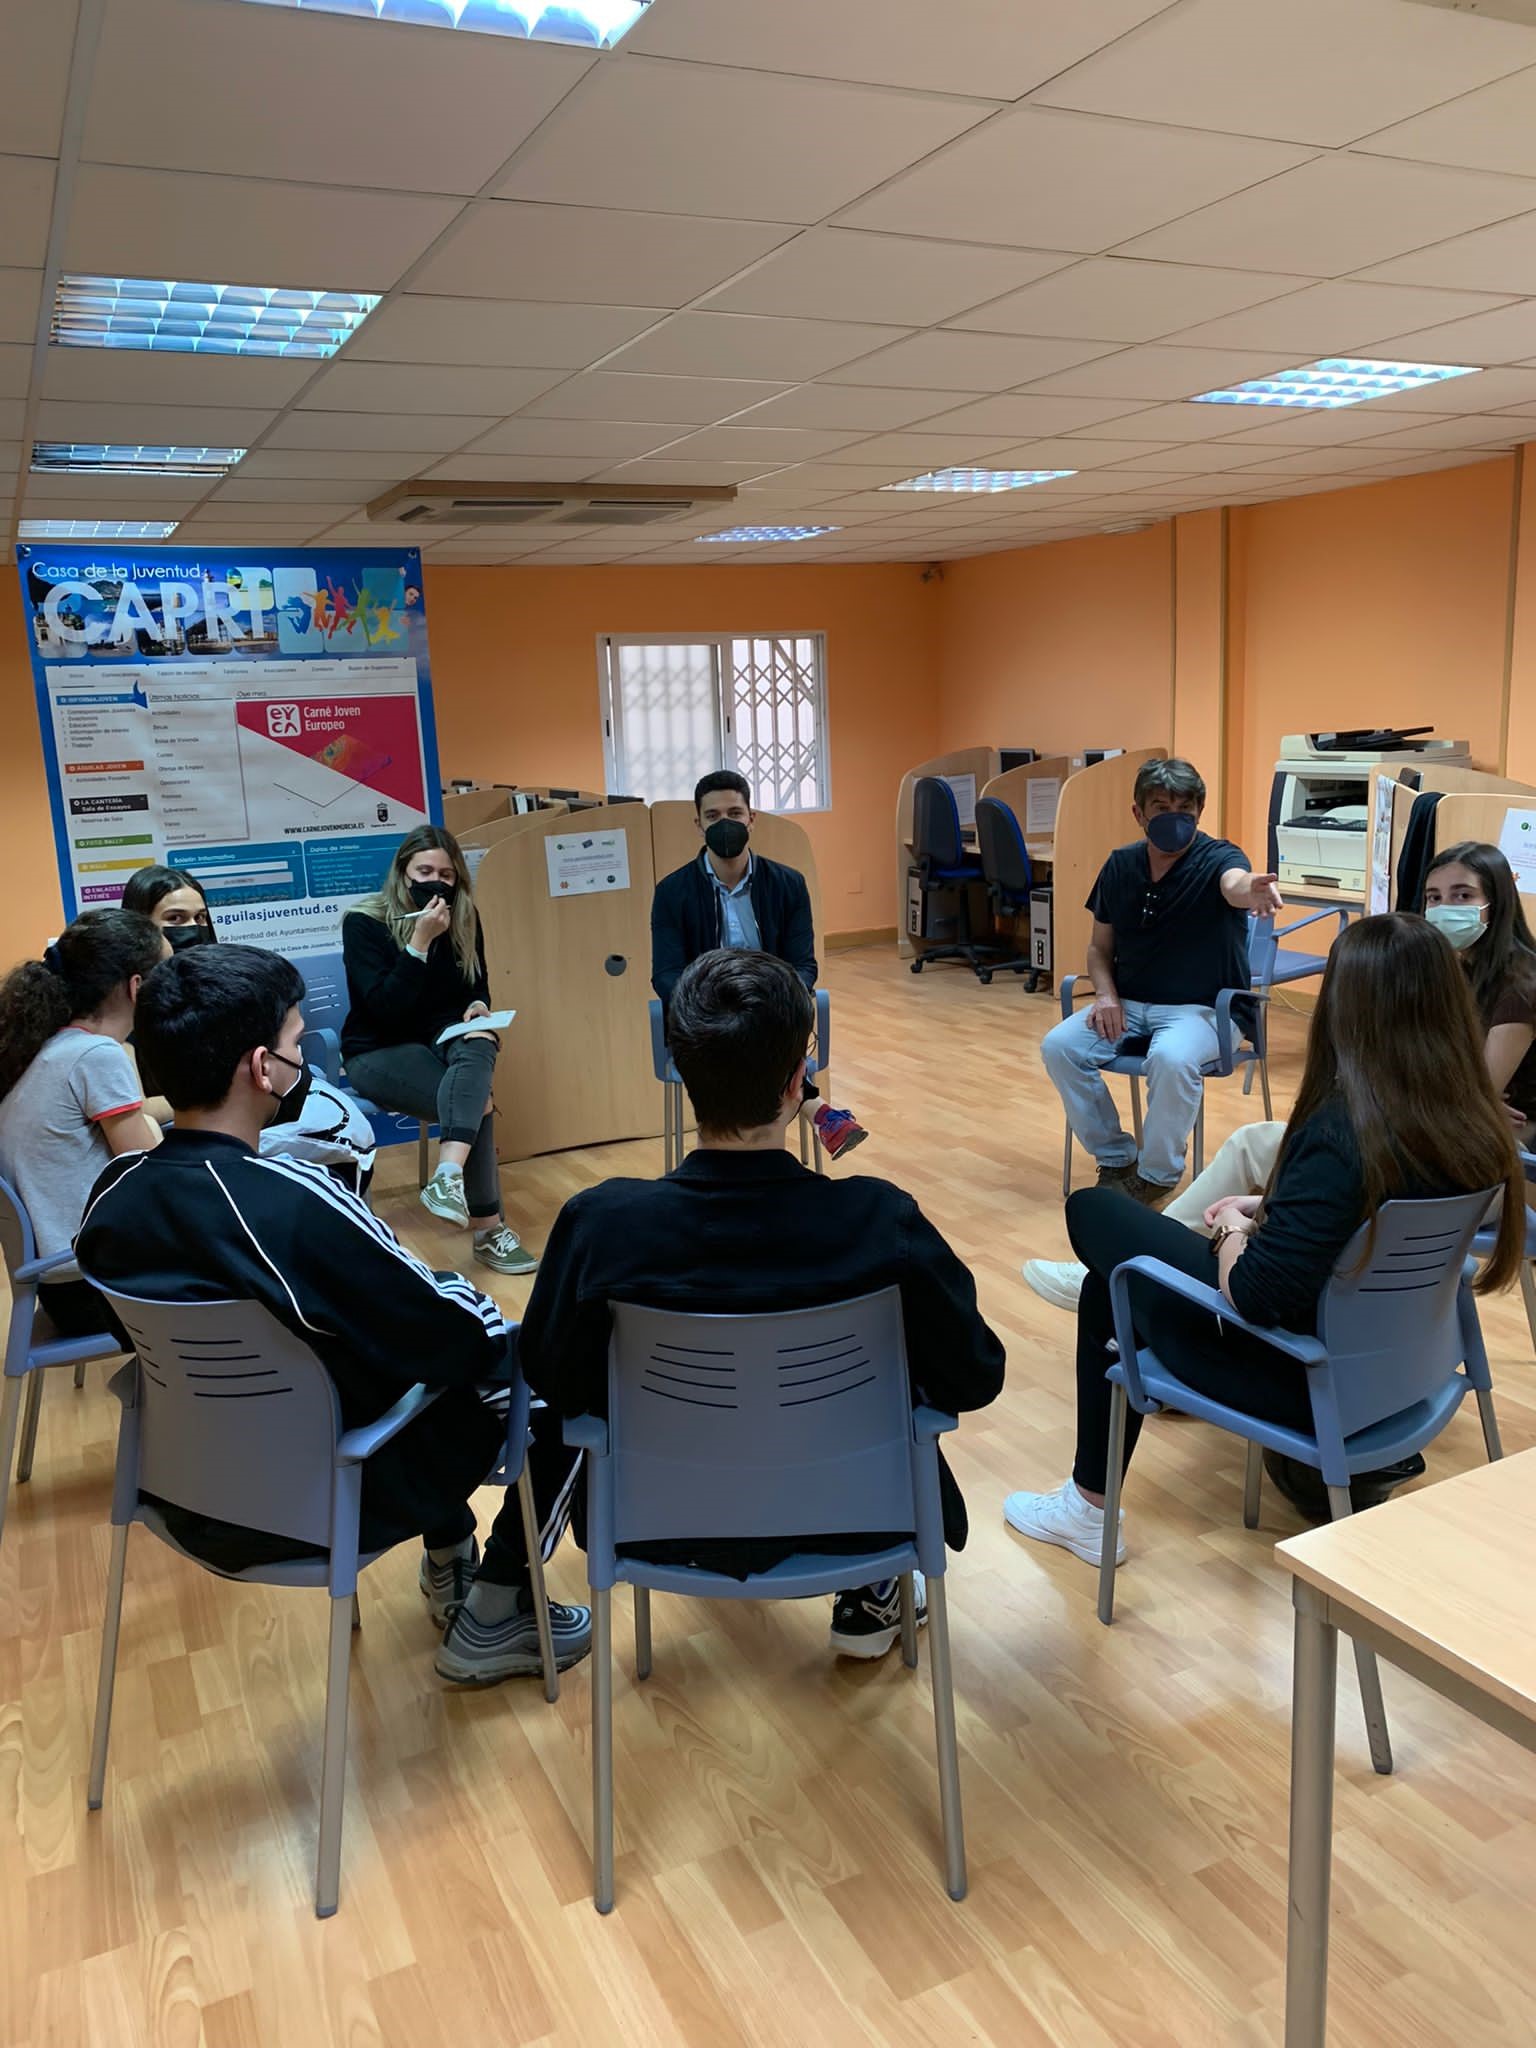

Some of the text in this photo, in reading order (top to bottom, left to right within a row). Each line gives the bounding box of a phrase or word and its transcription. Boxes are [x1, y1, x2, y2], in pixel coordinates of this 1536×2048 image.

[32, 562, 201, 580] Casa de la Juventud
[43, 580, 266, 645] CAPRI
[303, 705, 362, 719] Carné Joven
[304, 719, 346, 732] Europeo
[229, 931, 265, 942] Juventud
[266, 928, 278, 938] del
[279, 925, 330, 938] Ayuntamiento
